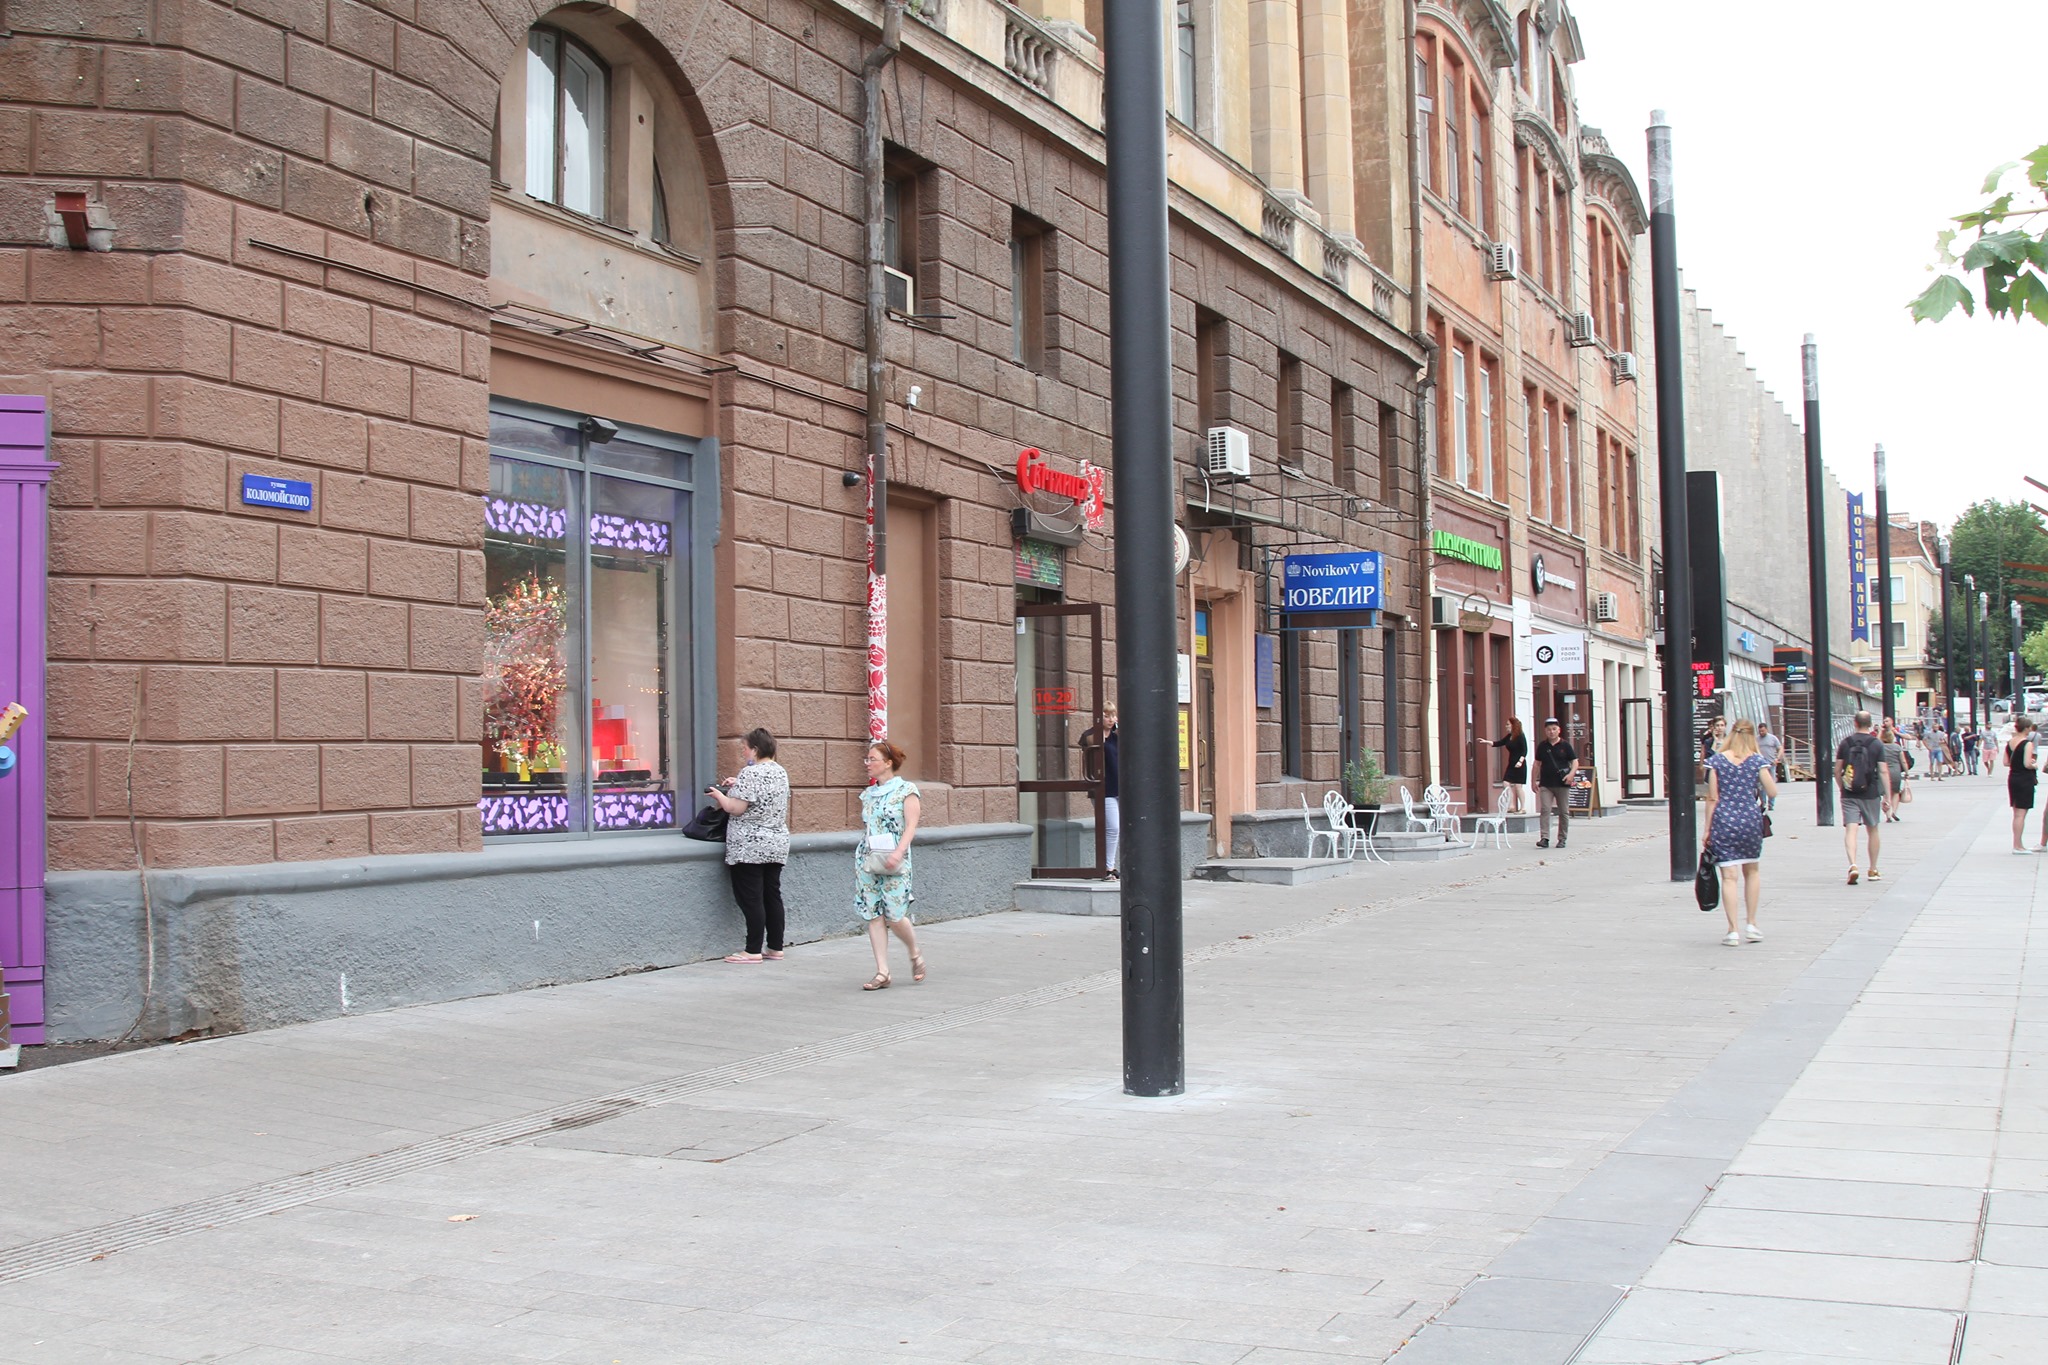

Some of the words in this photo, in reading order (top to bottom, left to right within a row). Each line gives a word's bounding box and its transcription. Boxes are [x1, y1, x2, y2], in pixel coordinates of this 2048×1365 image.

[246, 487, 310, 506] КОЛОМОЙСКОГО
[1853, 505, 1864, 573] НОЧНОЙ
[1432, 529, 1503, 572] ЛЮКСОПТИКА
[1302, 563, 1360, 578] NovikovV
[1288, 585, 1375, 607] ЮВЕЛИР
[1855, 582, 1866, 628] КЛУБ
[1036, 691, 1072, 704] 10-20
